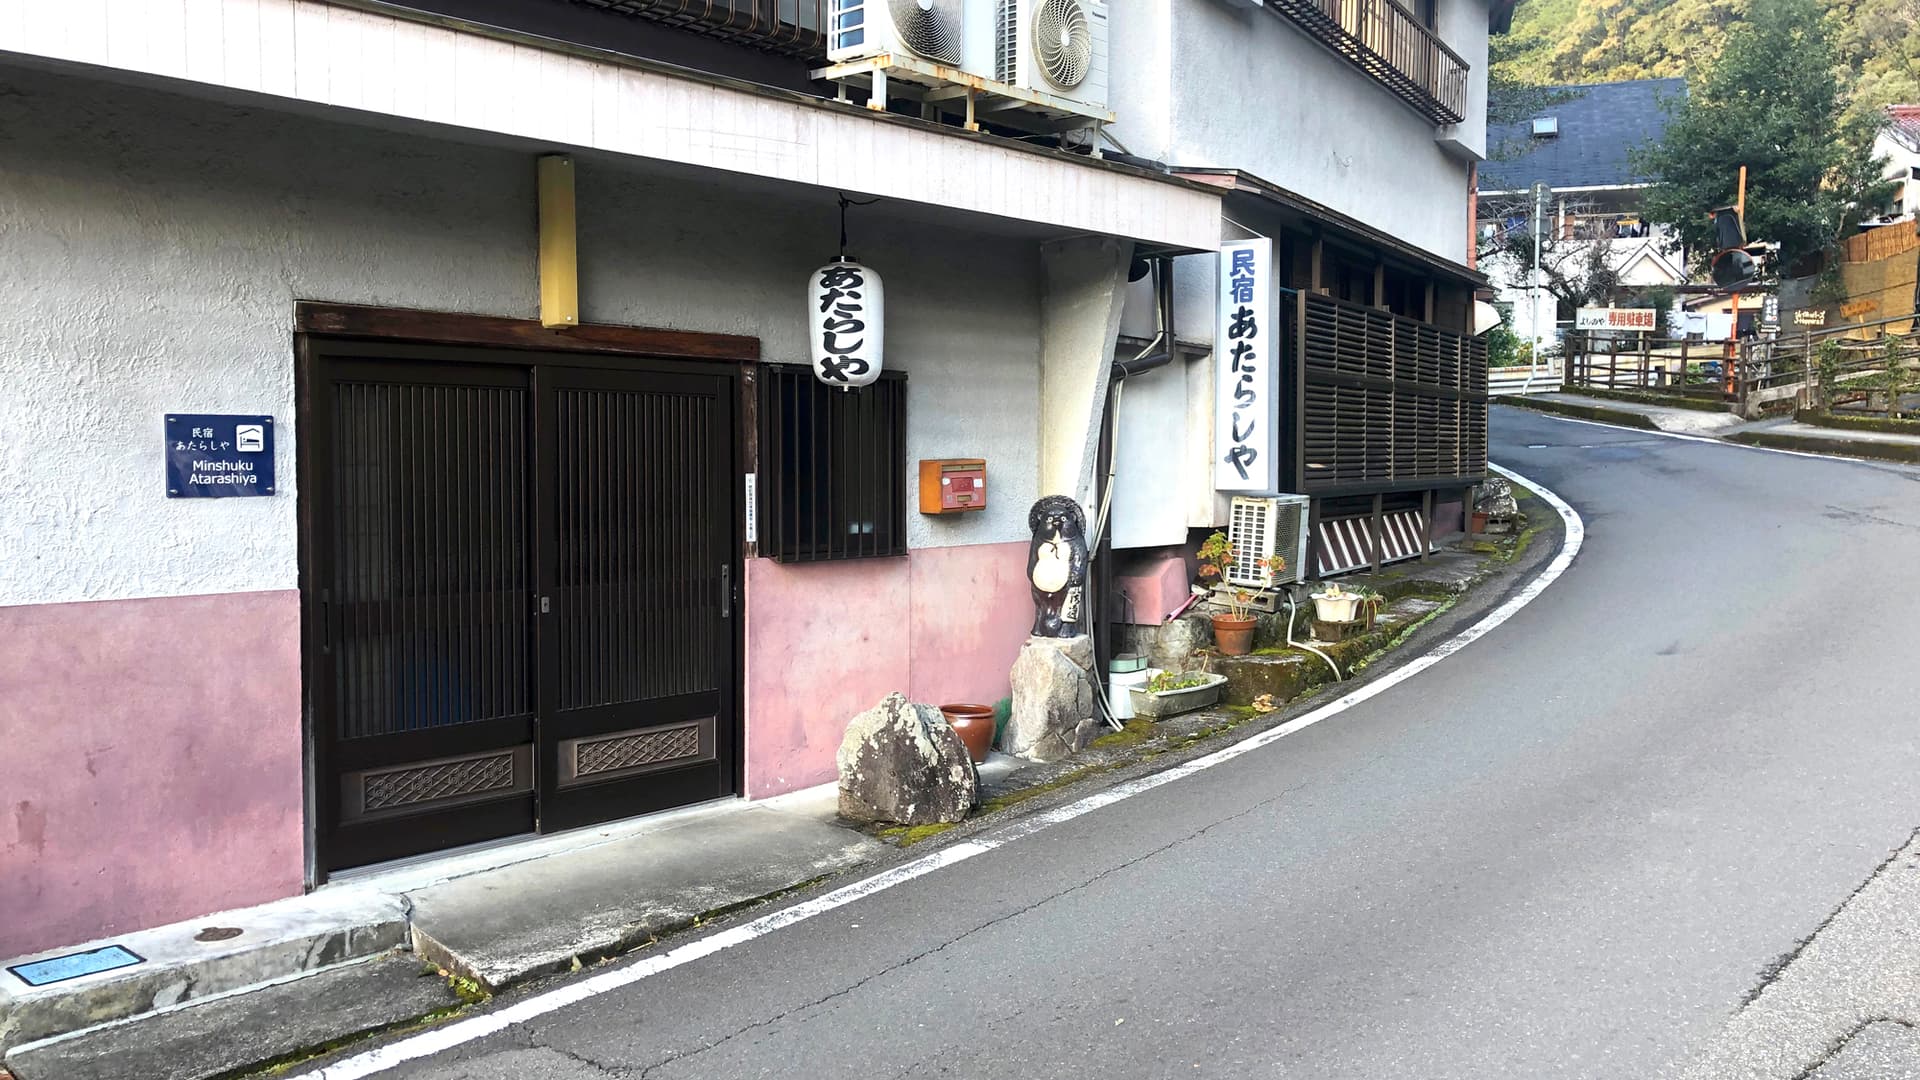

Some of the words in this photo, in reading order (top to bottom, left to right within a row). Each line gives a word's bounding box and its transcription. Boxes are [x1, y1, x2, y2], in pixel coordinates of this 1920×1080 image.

[820, 266, 870, 382] あたらしや
[1608, 312, 1654, 327] 専用駐車場
[192, 427, 214, 439] 民宿
[175, 441, 230, 451] あたらしや
[192, 460, 254, 471] Minshuku
[188, 473, 257, 486] Atarashiya
